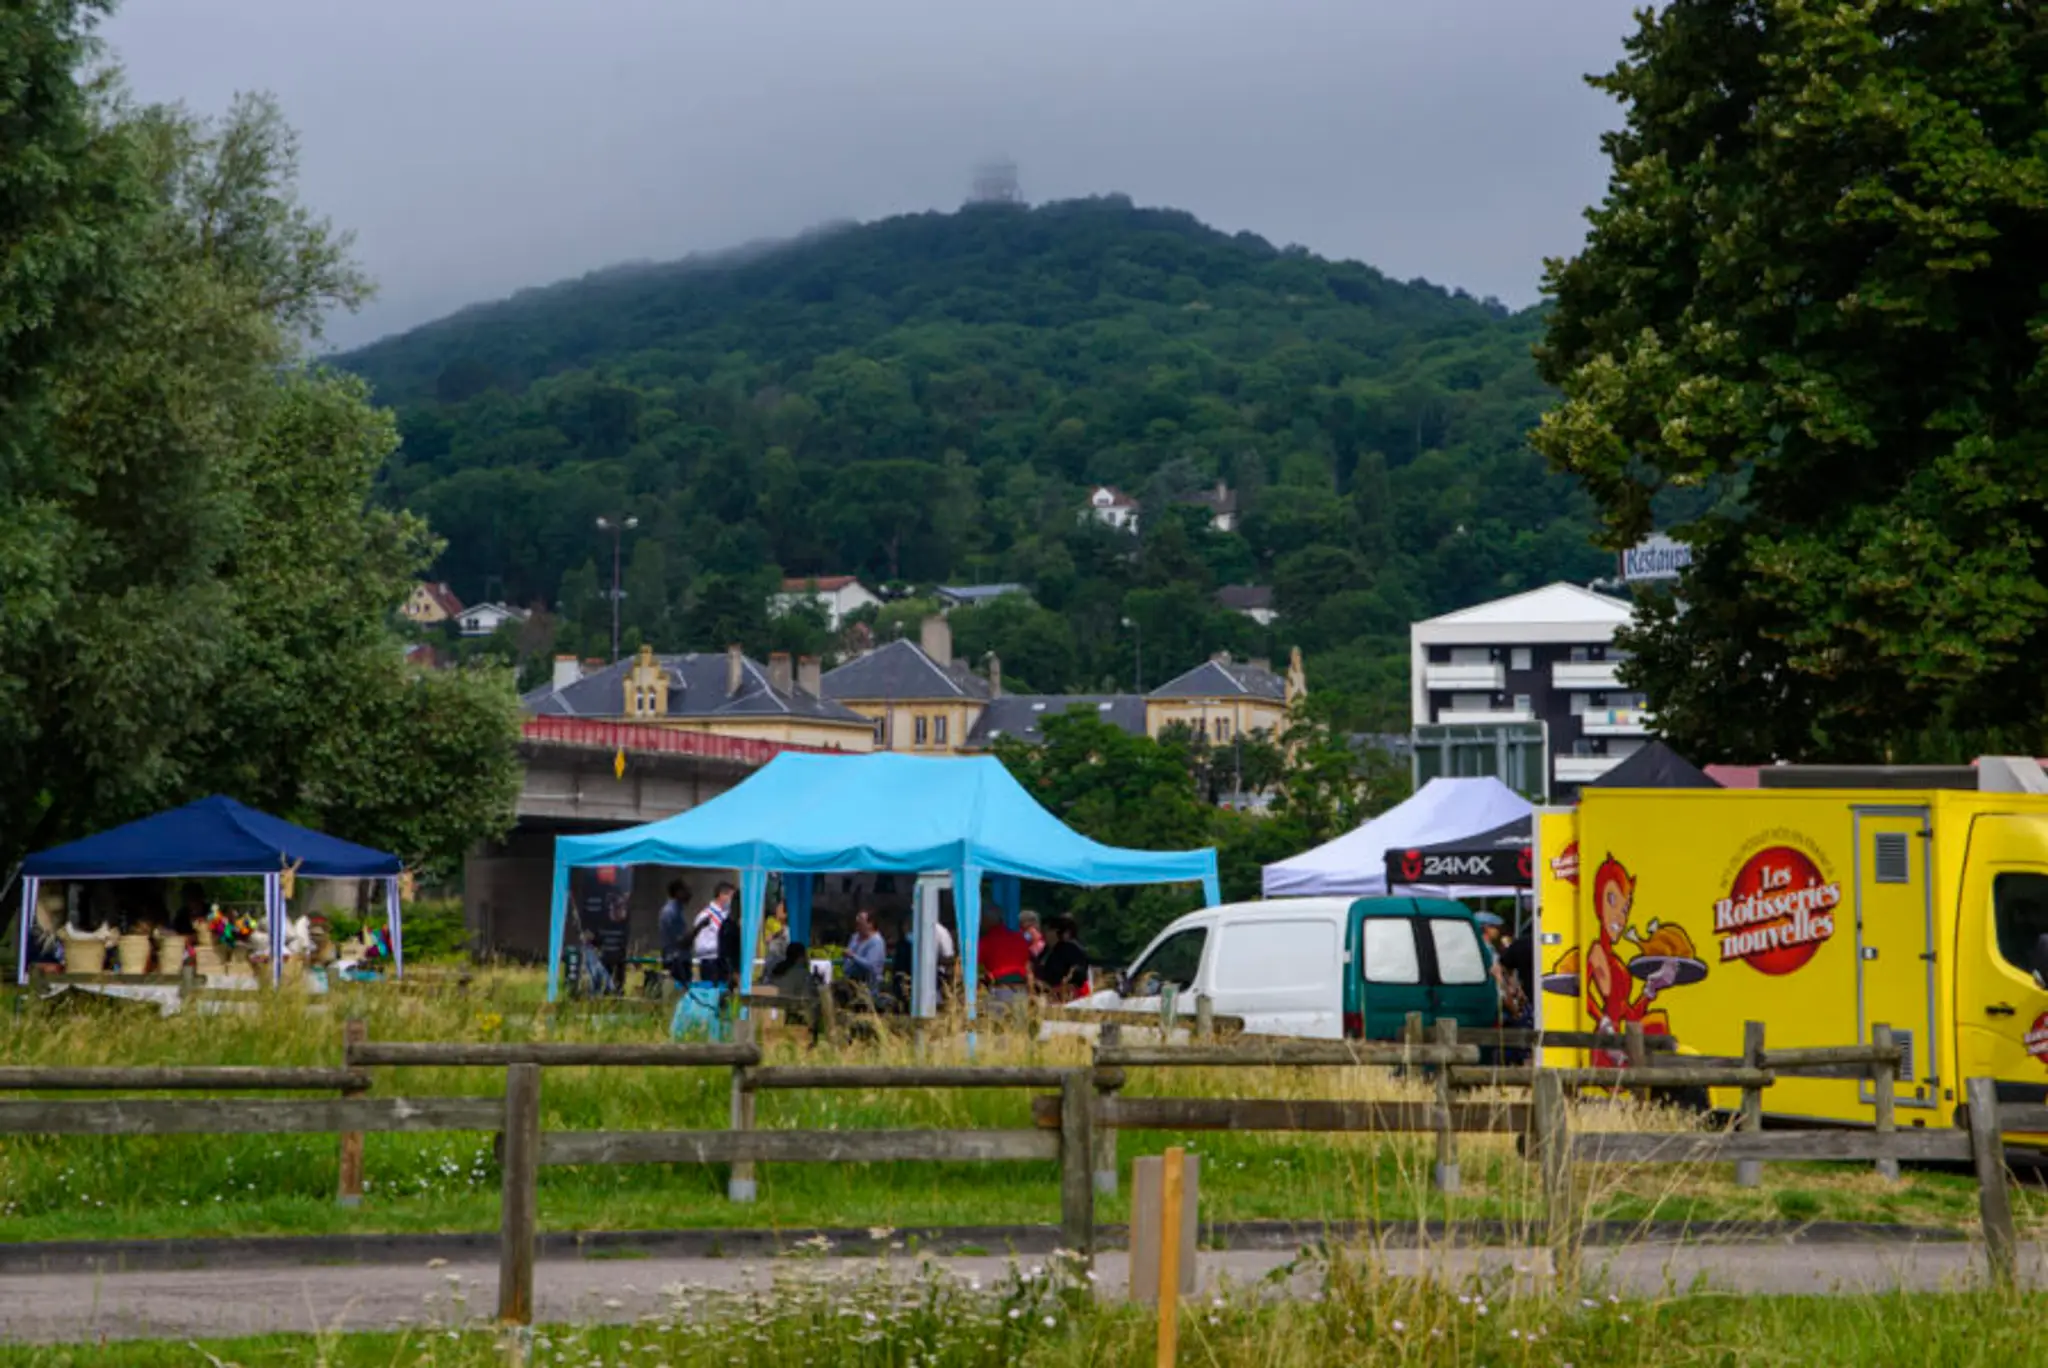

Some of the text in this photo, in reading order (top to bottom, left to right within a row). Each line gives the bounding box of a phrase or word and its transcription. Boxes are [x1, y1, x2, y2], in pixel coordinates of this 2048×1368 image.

[1424, 856, 1493, 875] 24MX
[1762, 865, 1792, 889] Les
[1714, 877, 1841, 930] Rôtisseries
[1722, 909, 1834, 958] nouvelles
